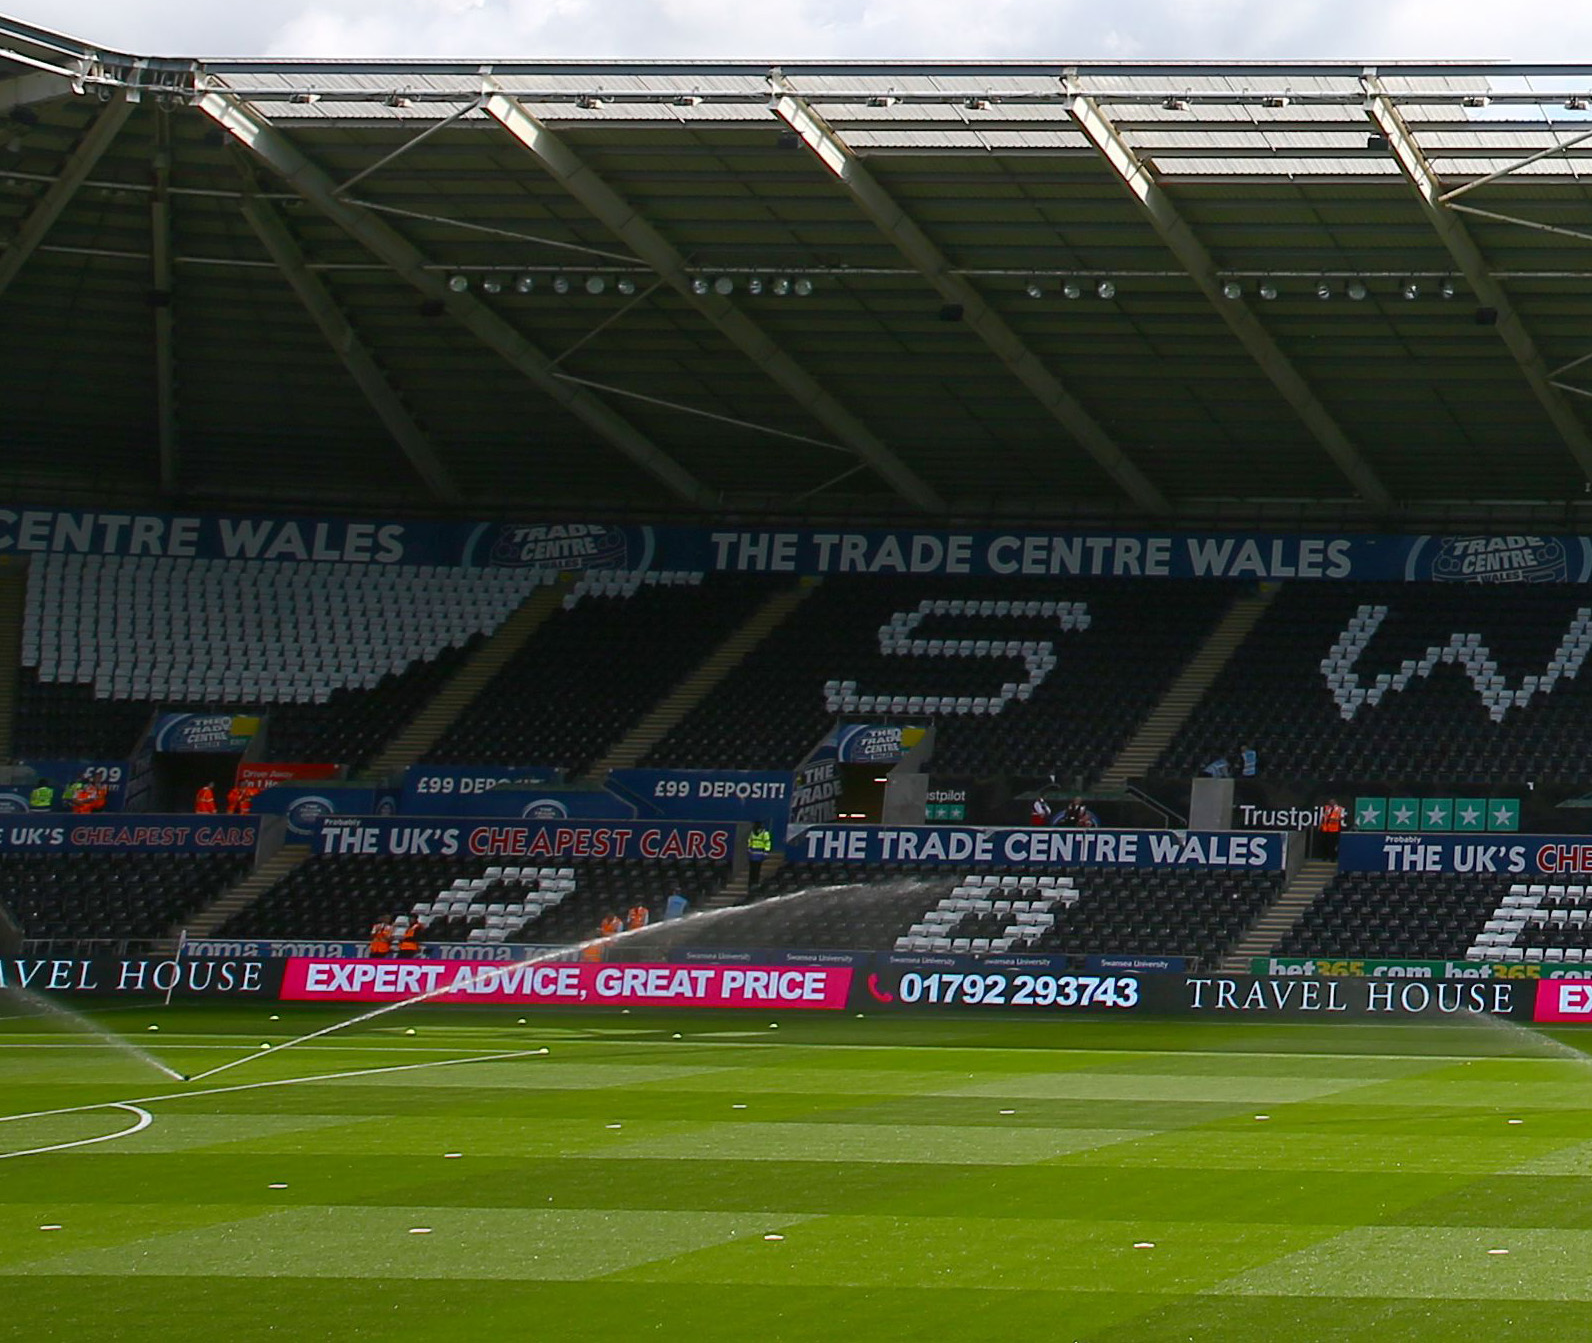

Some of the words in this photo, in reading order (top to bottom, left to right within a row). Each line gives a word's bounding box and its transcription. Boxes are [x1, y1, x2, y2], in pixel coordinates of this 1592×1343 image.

[218, 518, 405, 564] WALES
[513, 522, 608, 542] TRADE
[1453, 535, 1545, 555] TRADE
[519, 537, 601, 562] CENTRE
[711, 531, 799, 572] THE
[812, 533, 974, 574] TRADE
[987, 535, 1172, 577] CENTRE
[1188, 538, 1353, 579] WALES
[1461, 548, 1538, 574] CENTRE
[1479, 570, 1523, 584] WALES
[417, 777, 454, 795] £99
[804, 763, 835, 785] THE
[654, 780, 691, 798] £99
[698, 781, 787, 800] DEPOSIT!
[793, 779, 843, 808] TRADE
[1239, 803, 1349, 832] Trustpilt
[70, 826, 190, 847] CHEAPEST
[195, 827, 256, 847] CARS
[321, 827, 380, 855] THE
[389, 827, 460, 856] UK'S
[468, 825, 634, 858] CHEAPEST
[639, 828, 729, 860] CARS
[806, 830, 873, 861] THE
[878, 830, 993, 862] TRADE
[1004, 832, 1138, 863] CENTRE
[1148, 833, 1269, 866] WALES
[1384, 835, 1422, 845] Probably
[1383, 844, 1443, 873] THE
[1453, 845, 1527, 874] UK'S
[117, 959, 263, 992] HOUSE
[1100, 957, 1133, 968] Swansea
[1133, 958, 1169, 970] University
[304, 963, 446, 994] EXPERT
[451, 965, 589, 1001] ADVICE,
[595, 967, 716, 999] GREAT
[721, 969, 828, 1001] PRICE
[899, 972, 1006, 1005] 01792
[1010, 974, 1139, 1009] 293743
[1185, 978, 1348, 1011] TRAVEL
[1367, 982, 1514, 1014] HOUSE
